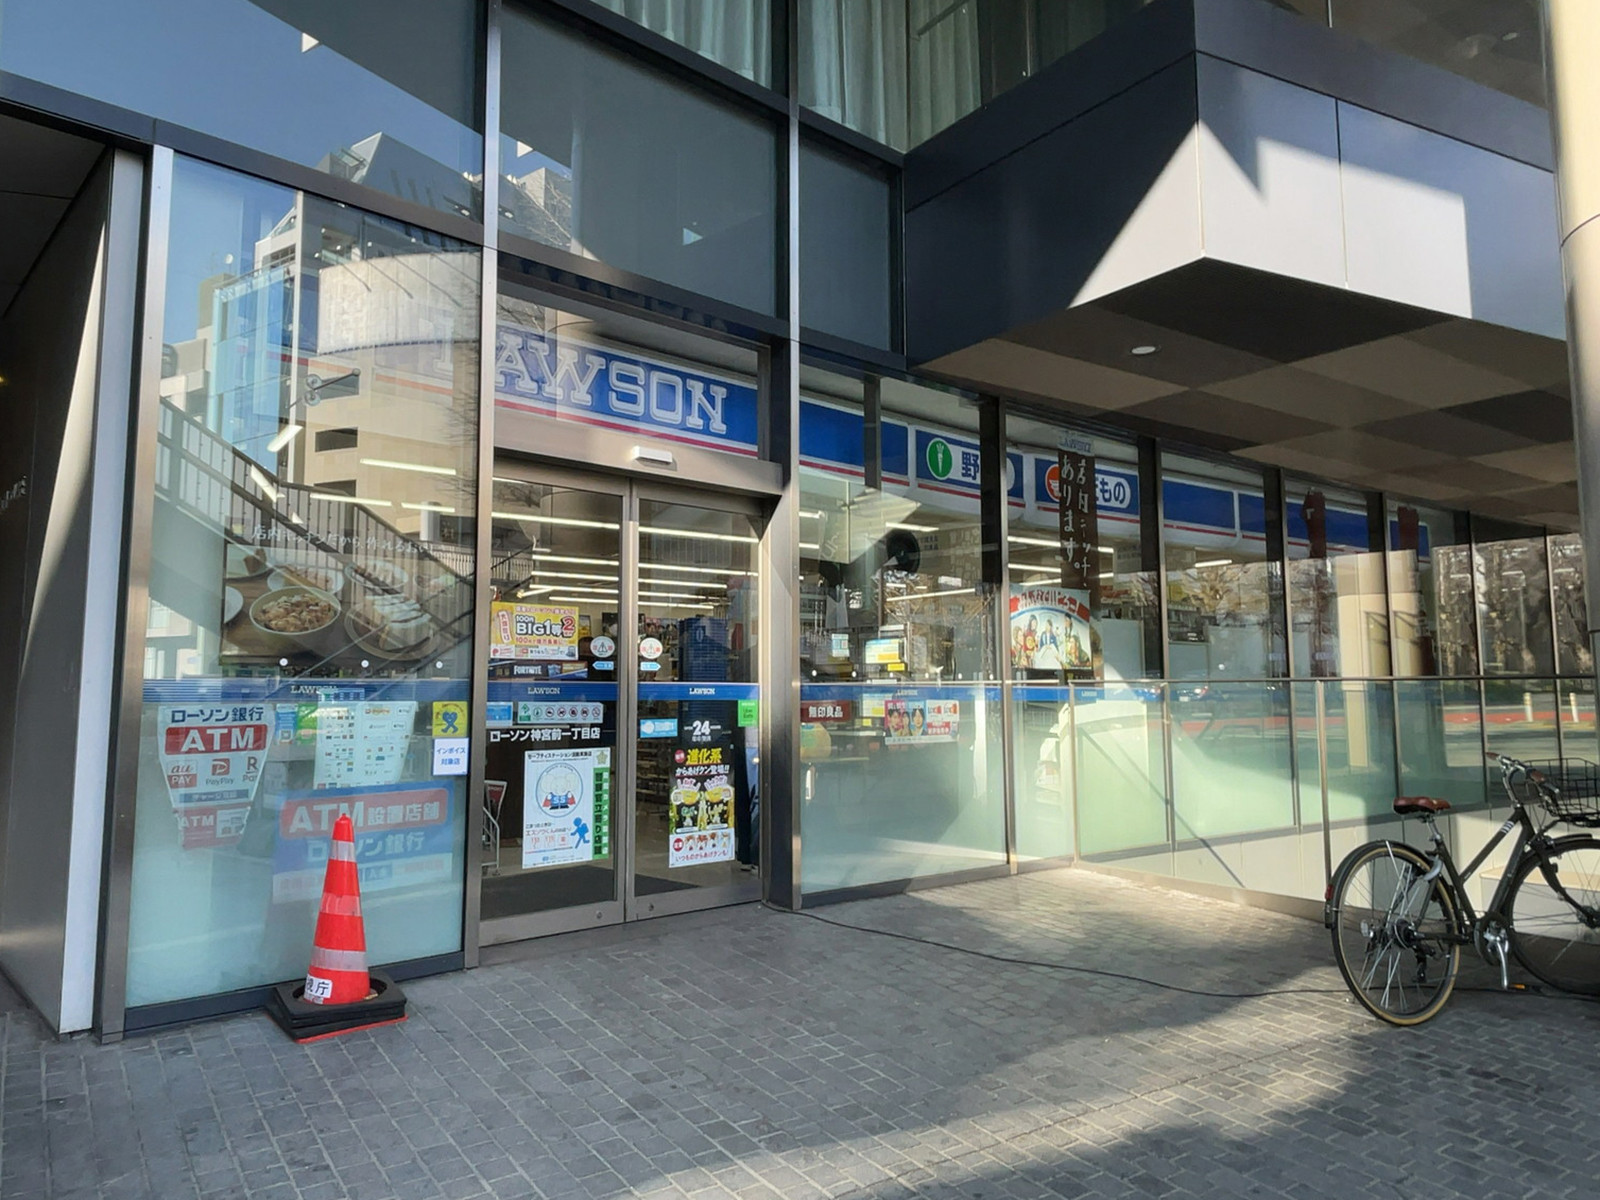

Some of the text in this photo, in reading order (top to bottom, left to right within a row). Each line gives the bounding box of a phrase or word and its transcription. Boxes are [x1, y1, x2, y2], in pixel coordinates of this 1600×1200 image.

[563, 618, 575, 631] 2
[514, 665, 542, 675] FORTNITE
[528, 687, 561, 695] LAWSON
[171, 707, 264, 723] ローソン銀行
[808, 706, 844, 718] 無印良品
[692, 720, 711, 735] 24
[180, 727, 255, 752] ATM
[489, 727, 601, 743] ローソン神宮前一丁目店
[686, 748, 722, 765] 進化系
[171, 775, 191, 785] PAY
[206, 777, 235, 786] PayPay
[307, 832, 425, 862] ロソン銀行
